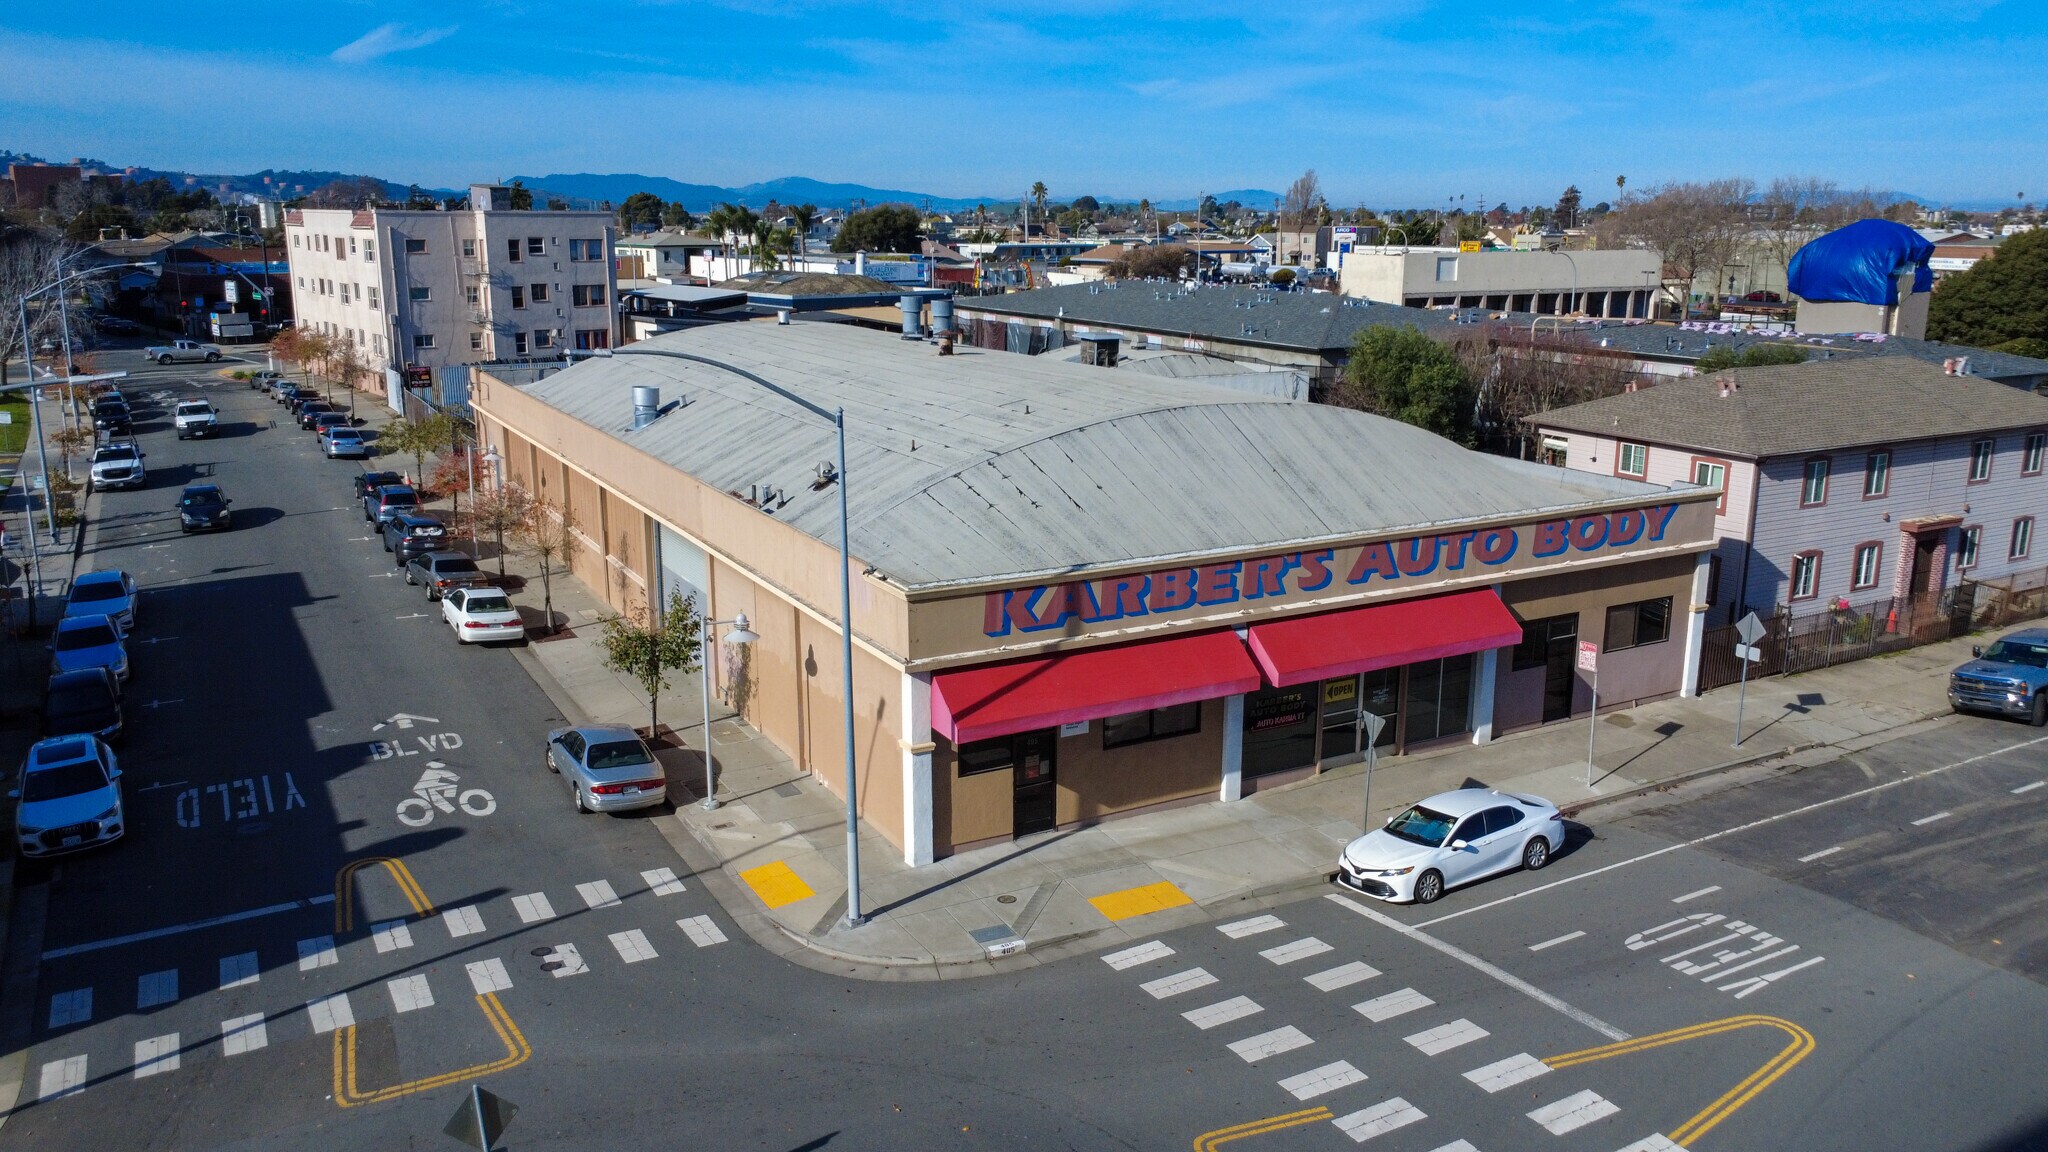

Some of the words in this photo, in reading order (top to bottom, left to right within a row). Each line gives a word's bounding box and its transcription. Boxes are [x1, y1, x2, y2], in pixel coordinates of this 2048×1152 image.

[983, 547, 1335, 638] KARBER'S
[1347, 525, 1519, 585] AUTO
[1531, 503, 1679, 559] BODY
[1333, 684, 1353, 697] OPEN
[1250, 705, 1278, 718] AUTO
[1280, 700, 1307, 712] BODY
[1256, 718, 1274, 728] AUTO
[368, 732, 463, 761] BLVD
[176, 772, 306, 828] YIELD
[1624, 913, 1826, 1000] YIELD
